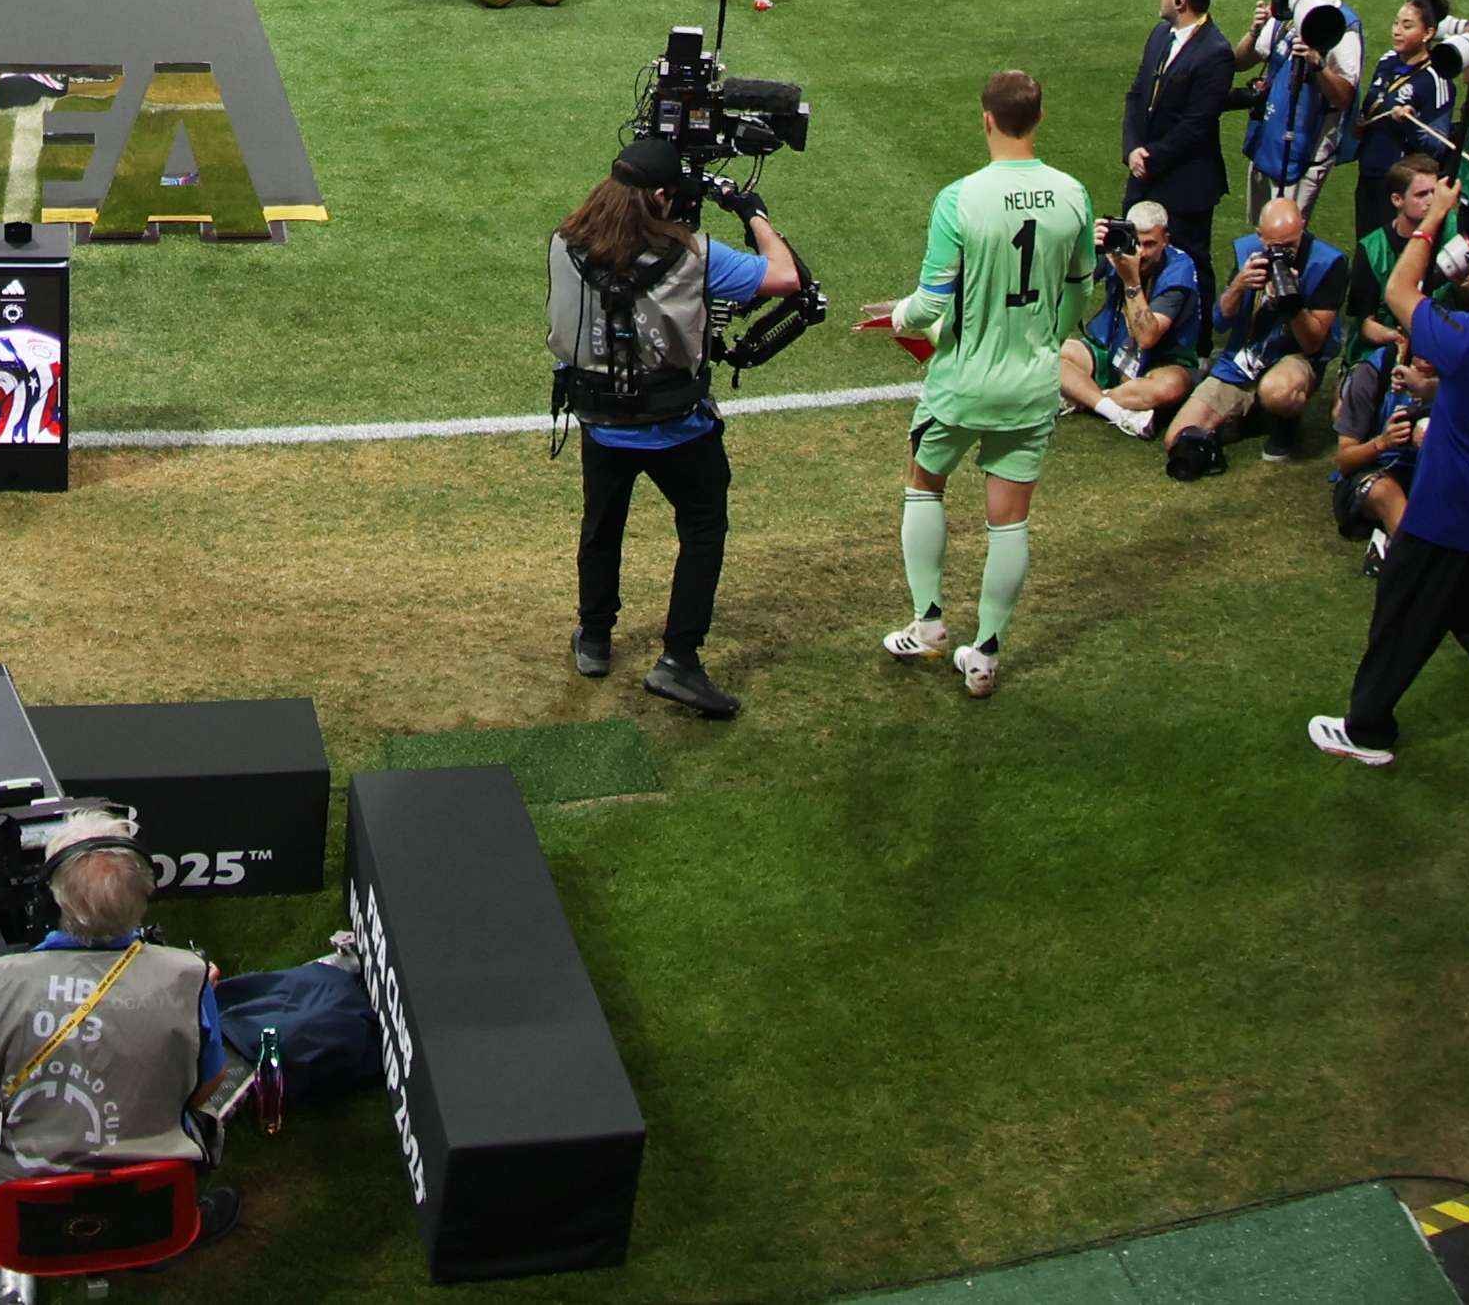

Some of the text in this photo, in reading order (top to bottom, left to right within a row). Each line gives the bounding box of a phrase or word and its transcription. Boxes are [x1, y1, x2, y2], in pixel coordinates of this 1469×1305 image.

[1003, 189, 1056, 212] NEUER
[1006, 219, 1040, 309] 1
[47, 974, 98, 1005] HB
[349, 876, 380, 1014] WORLD
[378, 1008, 400, 1091] CUP
[366, 883, 413, 1079] FIFA CLUB
[104, 1100, 119, 1147] CUP
